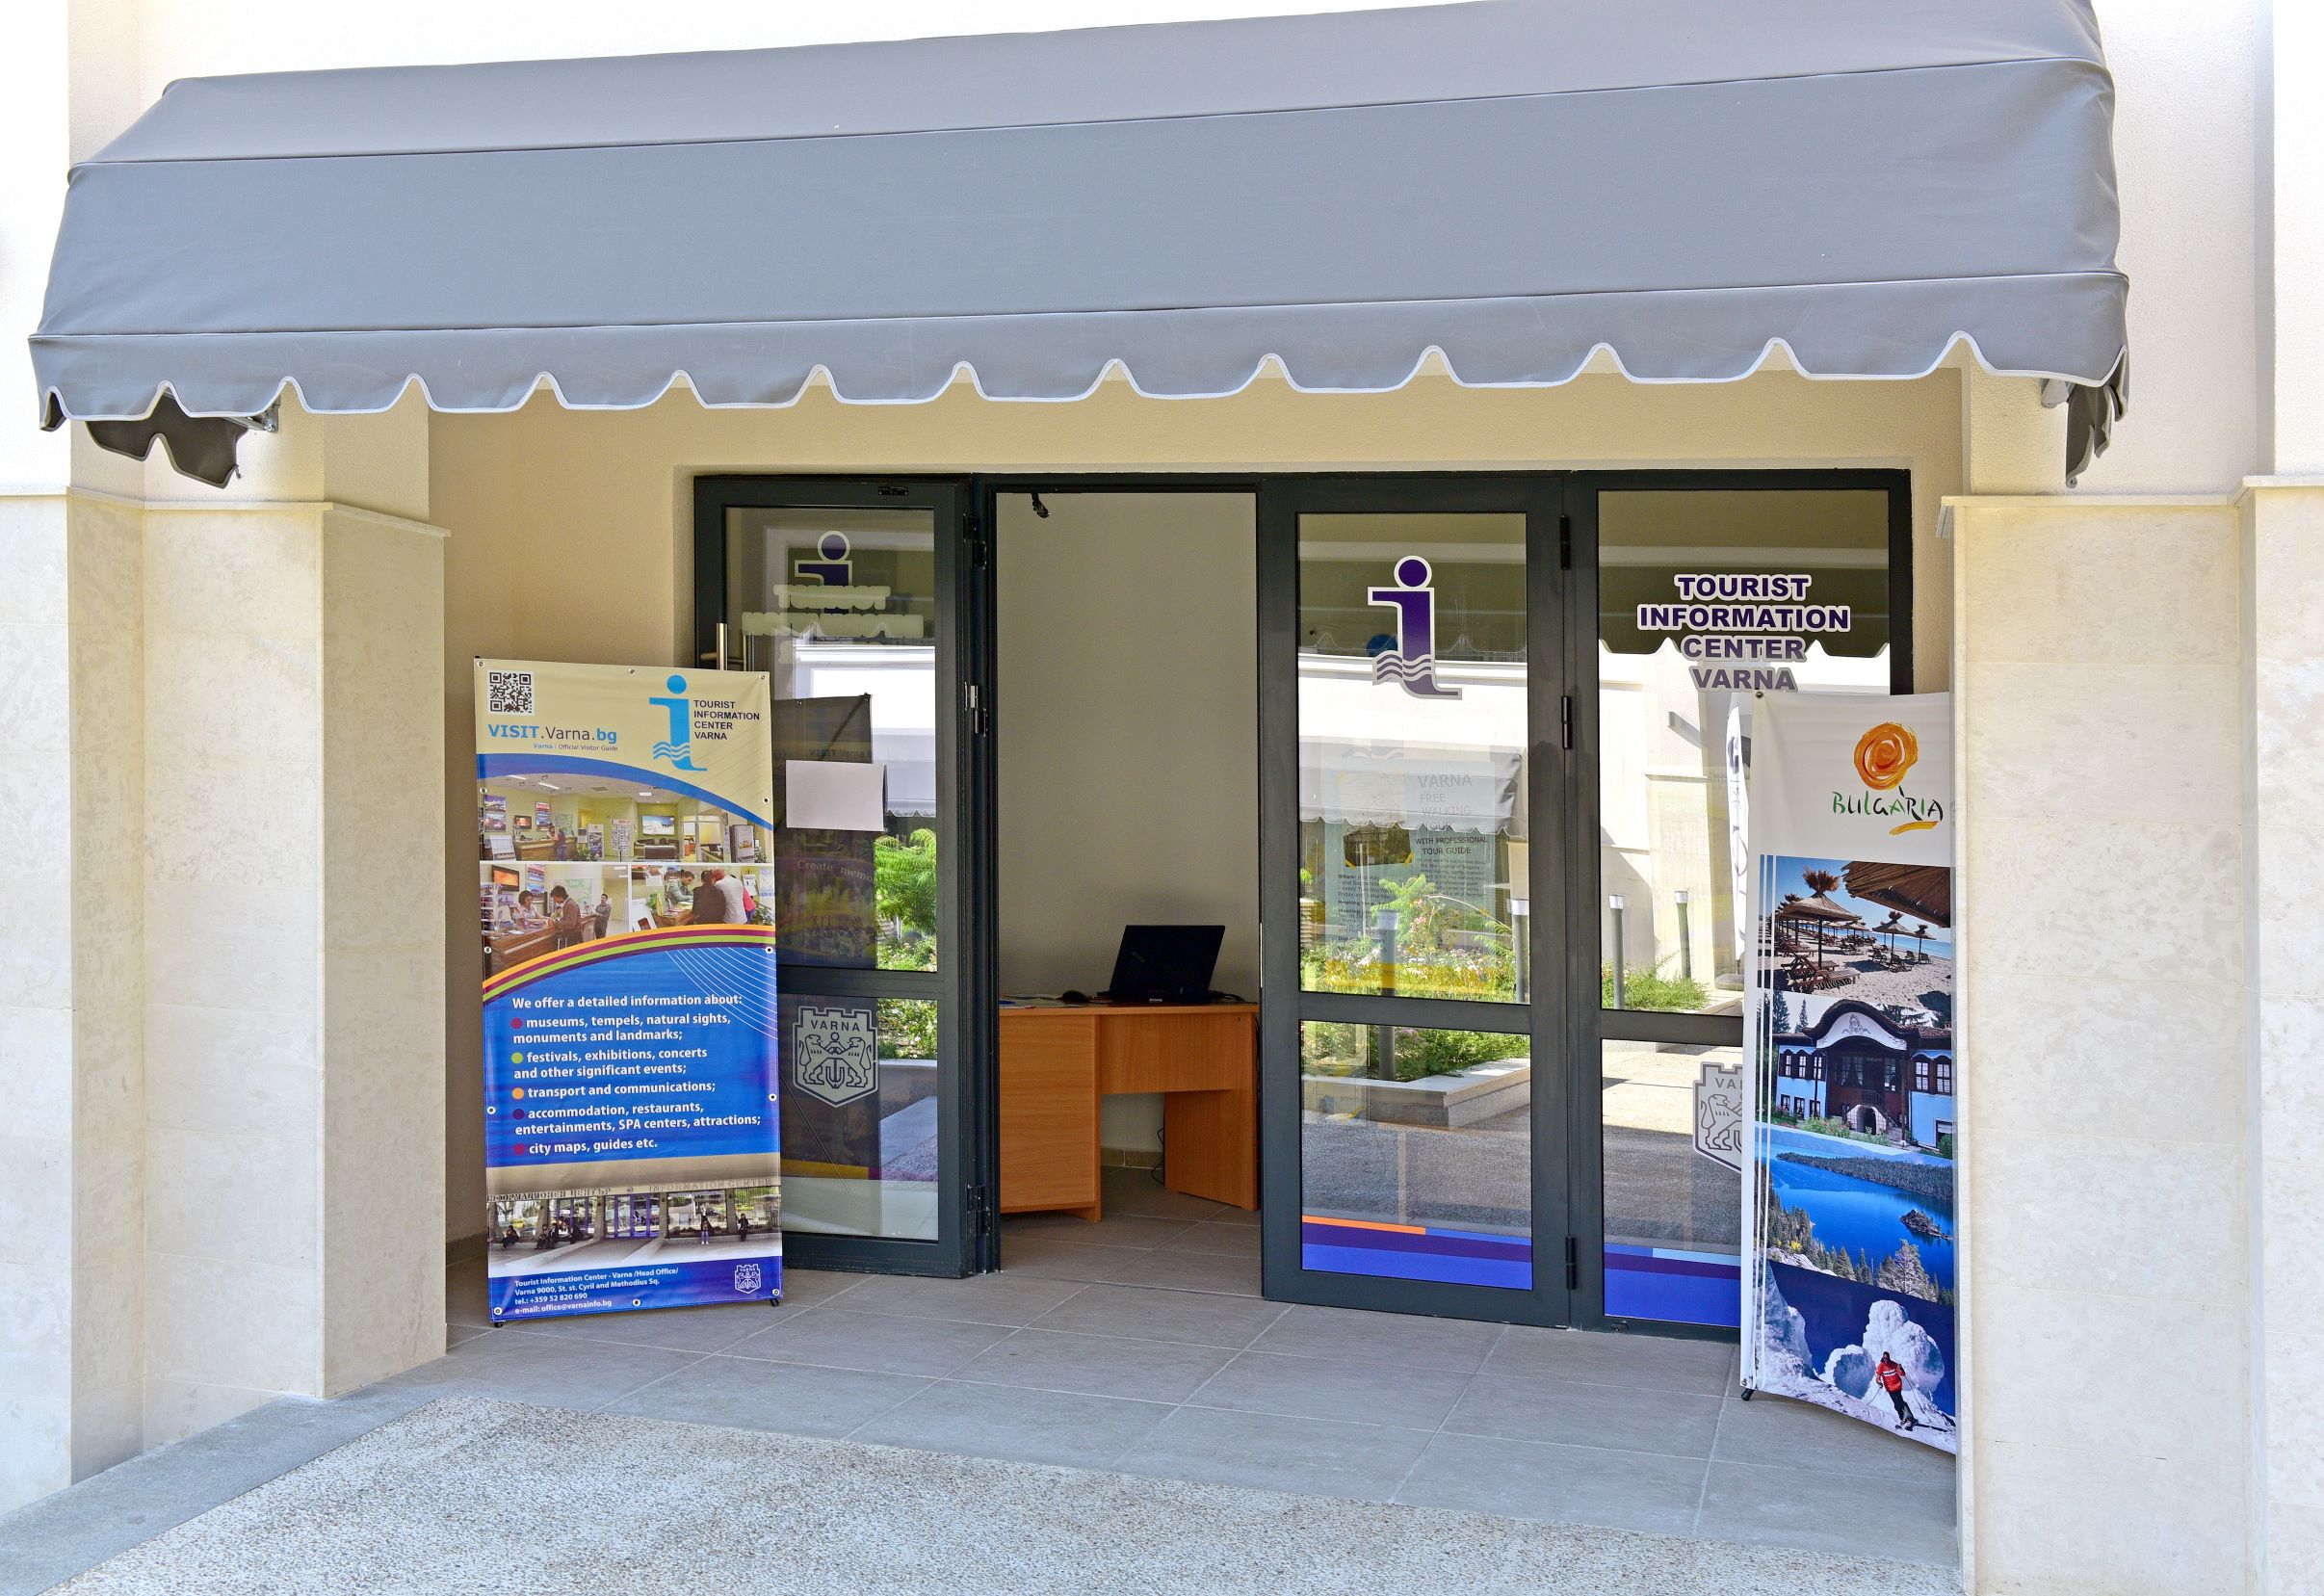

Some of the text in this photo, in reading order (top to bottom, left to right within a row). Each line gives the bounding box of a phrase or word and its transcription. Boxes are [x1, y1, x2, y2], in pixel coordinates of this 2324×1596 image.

[1676, 575, 1811, 599] TOURIST
[1639, 606, 1848, 630] INFORMATION
[1683, 636, 1806, 662] CENTER
[1691, 667, 1796, 691] VARNA
[693, 699, 736, 710] TOURIST
[693, 710, 760, 720] INFORMATION
[694, 720, 733, 730] CENTER
[487, 723, 617, 745] VISIT.Varna.bg
[694, 731, 728, 741] VARNA
[1417, 773, 1473, 788] VARNA
[1420, 793, 1447, 802] FREE
[1832, 785, 1944, 822] BULGARIA
[1436, 836, 1488, 845] PROFESSIONAL
[1446, 847, 1472, 855] GUIDE
[512, 994, 743, 1008] We offer a detailed information about:
[526, 1013, 731, 1029] museums, tempels, natural sights,
[810, 1019, 860, 1032] VARNA
[512, 1029, 683, 1044] monuments and landmarks;
[526, 1047, 707, 1063] festivals, exhibitions, concerts
[513, 1063, 687, 1080] and other significant events;
[527, 1081, 716, 1099] transport and communications;
[528, 1102, 704, 1119] accommodation, restaurants,
[514, 1113, 761, 1136] entertainments, SPA centers, attractions;
[529, 1138, 658, 1156] city maps, guides etc.
[514, 1278, 539, 1287] Tourist
[540, 1275, 583, 1285] Information
[634, 1269, 655, 1278] /Head
[536, 1287, 558, 1295] 9000,
[578, 1282, 594, 1291] Cyril
[611, 1278, 647, 1288] Methodius
[514, 1299, 613, 1314] e-mail: office@varnainfo.bg
[530, 1295, 548, 1304] +359
